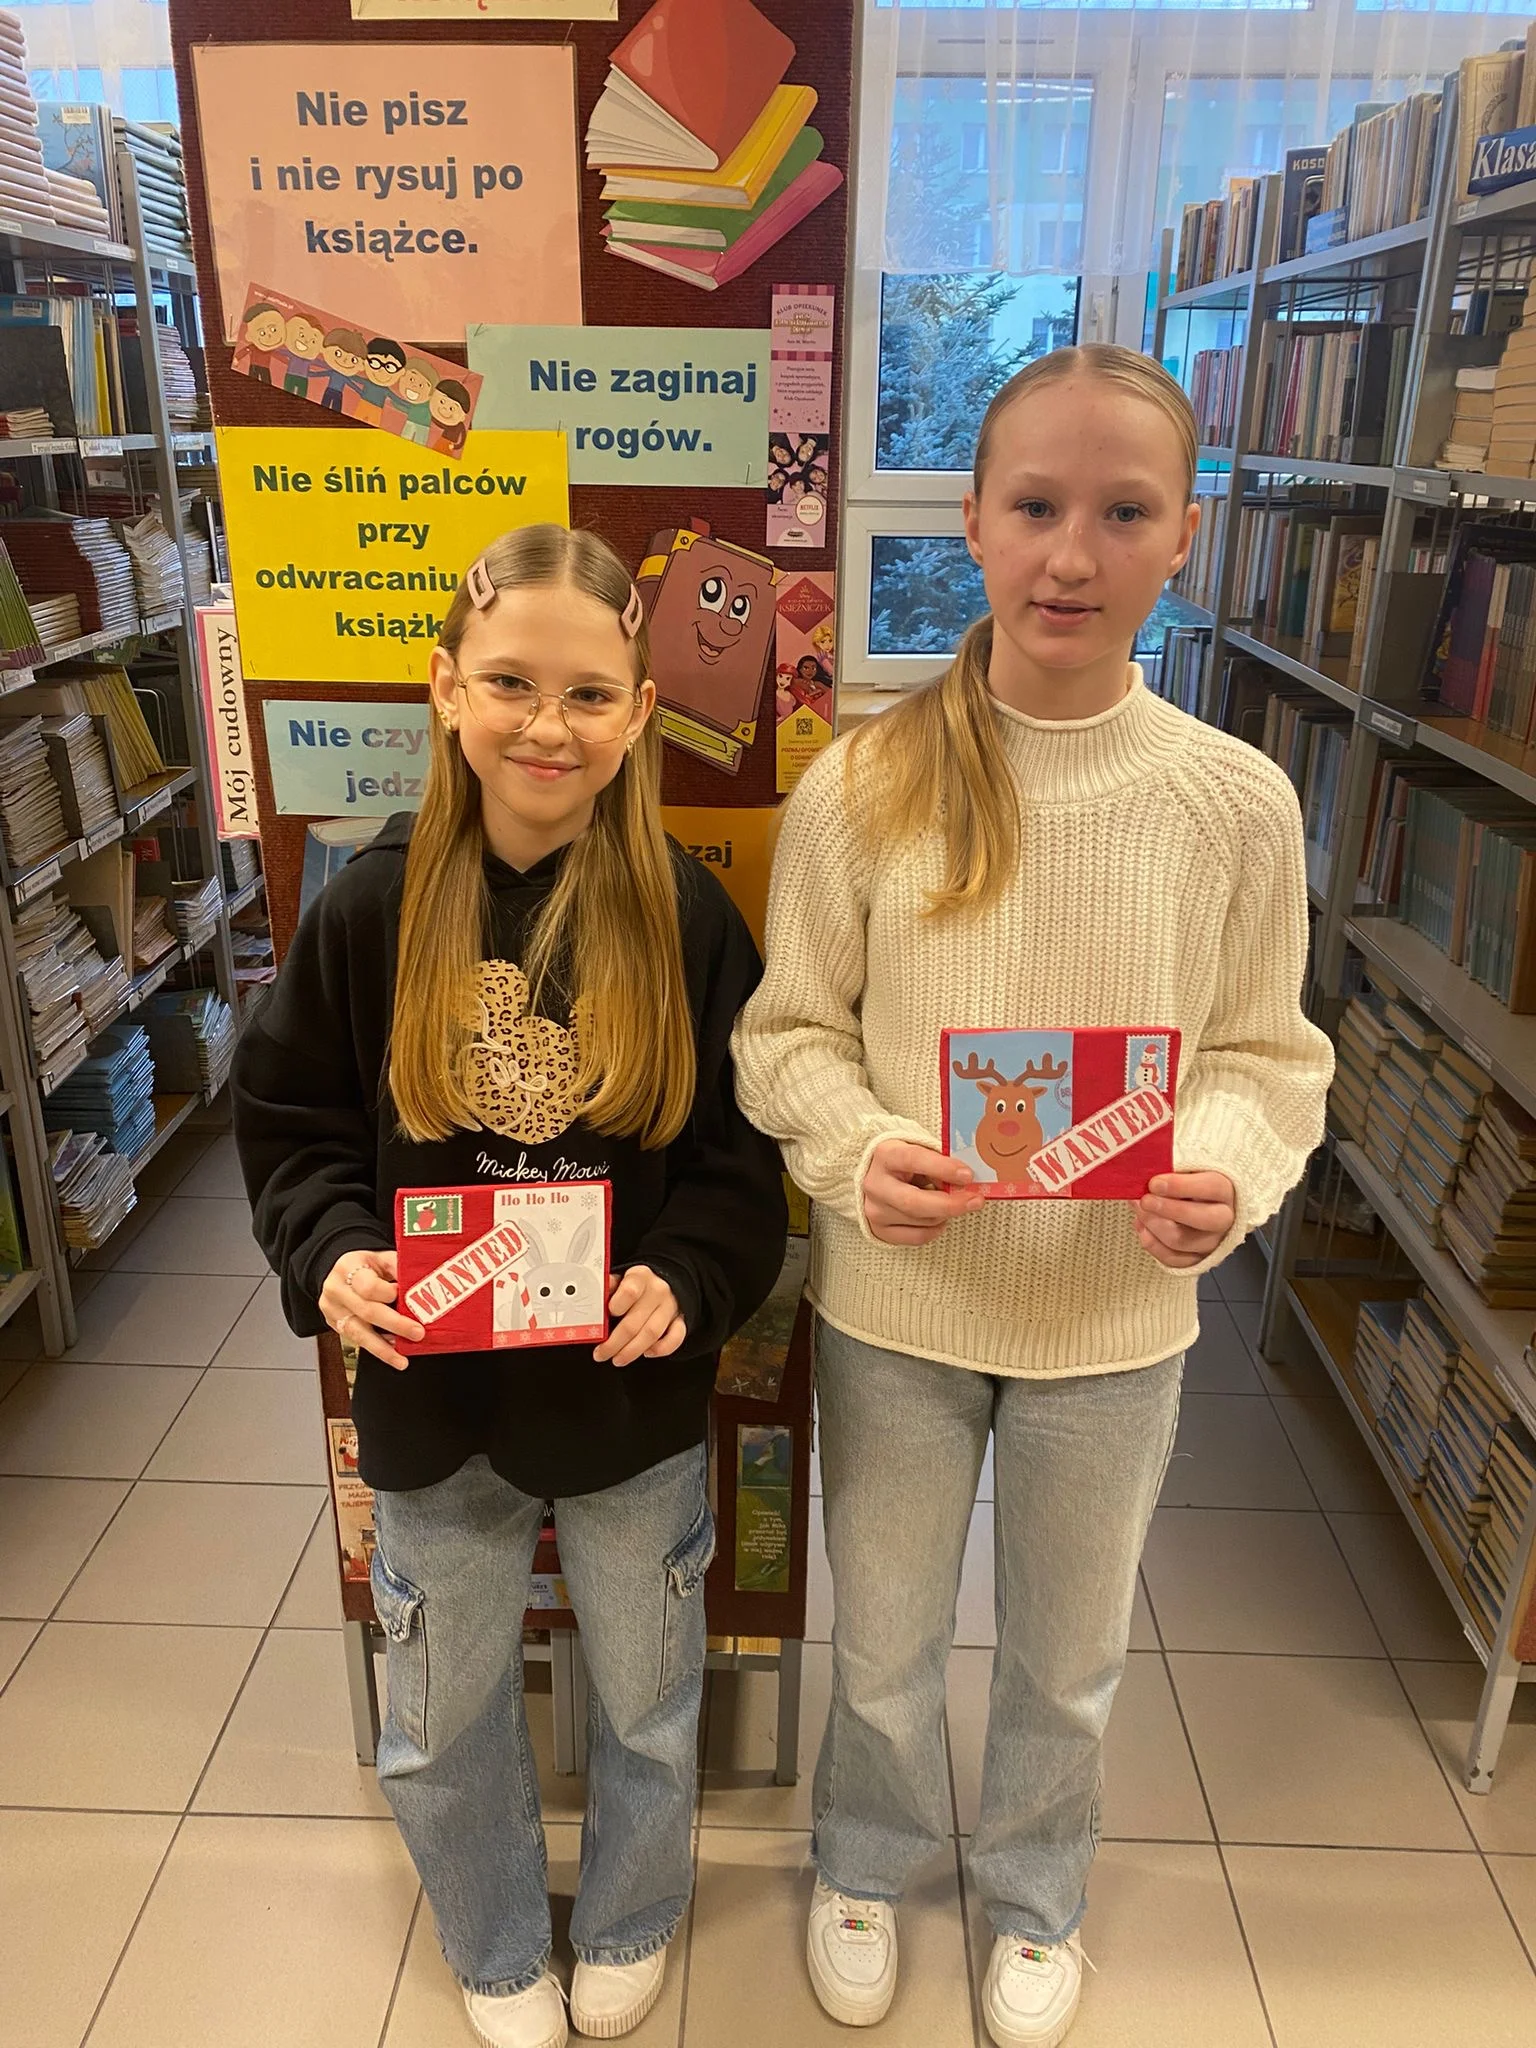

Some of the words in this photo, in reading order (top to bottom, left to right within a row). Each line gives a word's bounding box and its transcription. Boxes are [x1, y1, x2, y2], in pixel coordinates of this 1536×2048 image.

[296, 91, 368, 126] Nie
[383, 91, 468, 135] pisz
[250, 157, 262, 190] i
[277, 157, 341, 191] nie
[355, 157, 458, 200] rysuj
[473, 164, 523, 199] po
[305, 220, 478, 263] książce.
[530, 360, 597, 393] Nie
[610, 362, 757, 403] zaginaj
[575, 420, 713, 459] rogów.
[252, 465, 312, 492] Nie
[324, 466, 387, 494] śliń
[400, 468, 527, 501] palców
[357, 521, 430, 550] przy
[255, 564, 458, 592] odwracaniu
[335, 612, 445, 644] książk
[217, 627, 242, 757] cudowny
[288, 719, 351, 747] Nie
[361, 727, 430, 755] czy
[225, 769, 251, 823] Mój
[345, 770, 424, 803] jedz
[687, 841, 732, 869] zaj
[1033, 1091, 1165, 1185] WANTED
[476, 1151, 548, 1184] Mickey
[501, 1194, 521, 1207] Ho
[526, 1193, 545, 1205] Ho
[551, 1191, 569, 1204] Ho
[409, 1227, 522, 1316] WANTED
